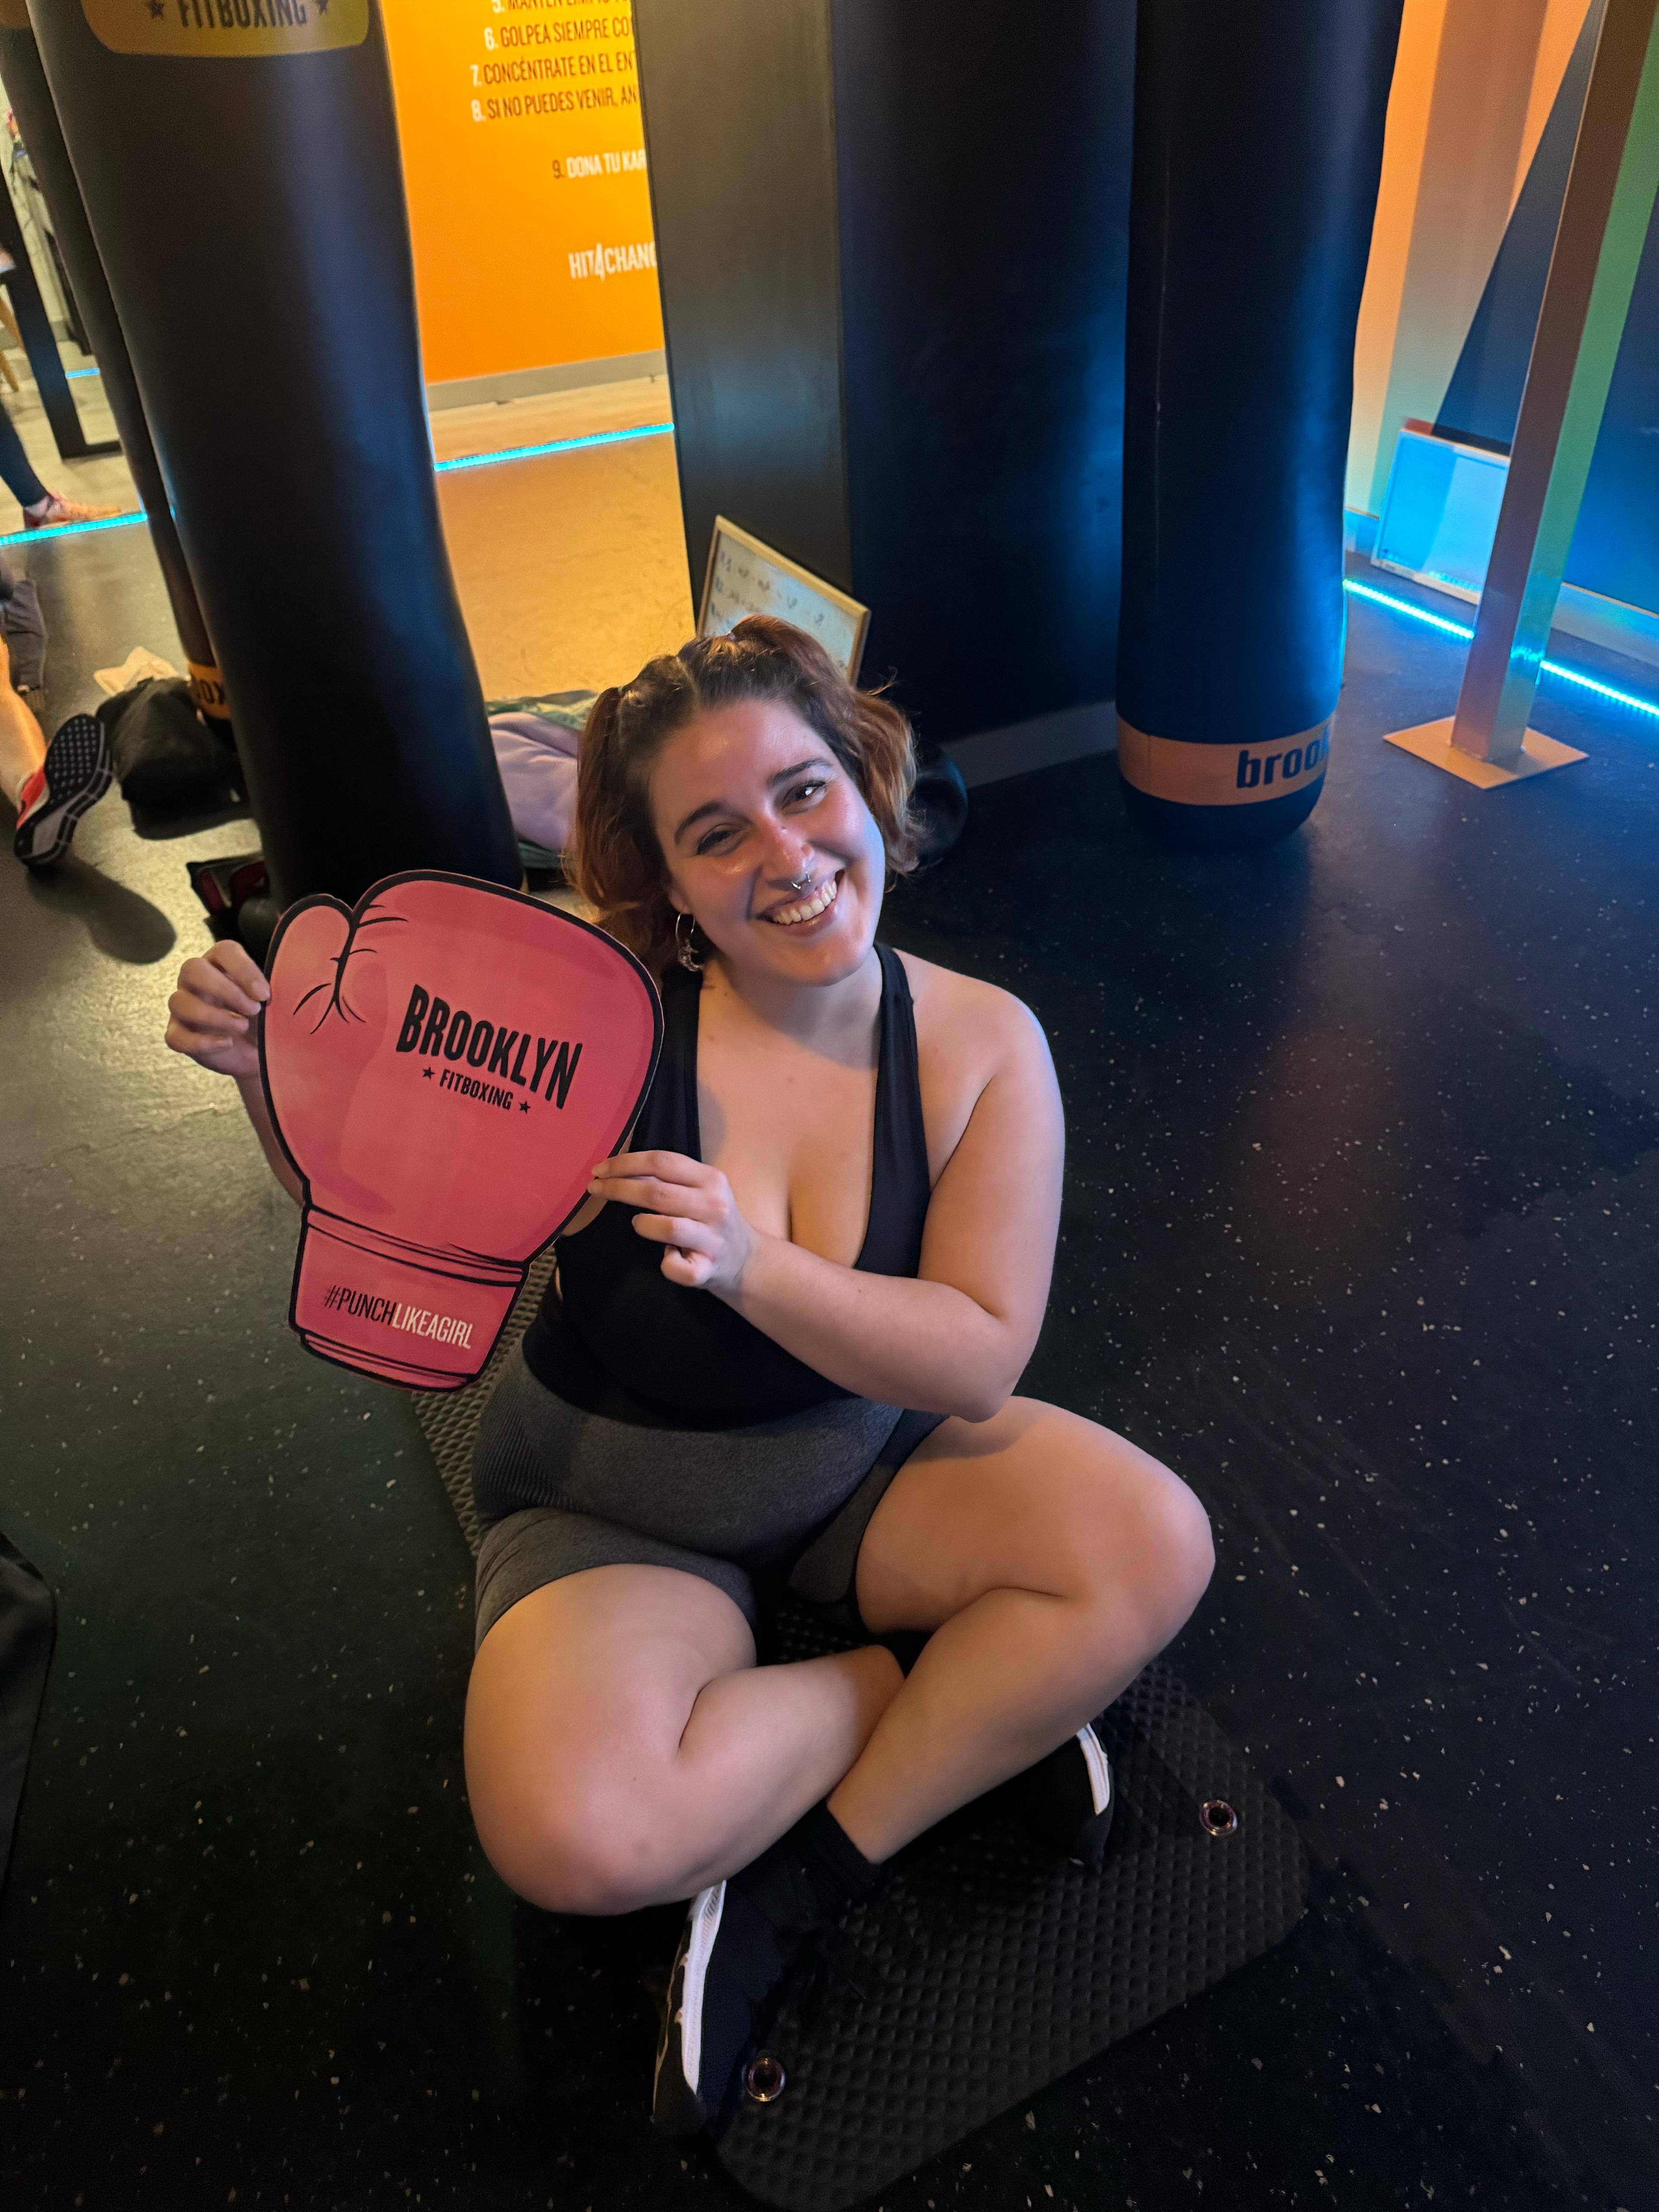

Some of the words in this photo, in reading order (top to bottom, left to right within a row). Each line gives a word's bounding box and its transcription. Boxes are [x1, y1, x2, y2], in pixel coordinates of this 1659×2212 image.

[484, 27, 499, 50] 6.
[499, 22, 551, 48] GOLPEA
[553, 18, 609, 42] SIEMPRE
[470, 64, 483, 87] 7.
[483, 56, 576, 84] CONCÉNTRATE
[578, 54, 595, 75] EN
[598, 53, 613, 73] EL
[616, 51, 636, 71] EN
[471, 99, 486, 122] 8.
[486, 99, 501, 120] SI
[502, 96, 522, 118] NO
[524, 91, 574, 114] PUEDES
[575, 87, 619, 109] VENIR,
[552, 159, 565, 179] 9.
[566, 154, 603, 179] DONA
[602, 152, 621, 174] TU
[396, 984, 583, 1109] BROOKLYN
[439, 1069, 514, 1110] FITBOXING
[324, 1284, 473, 1350] #PUNCHLIKEAGIRL
